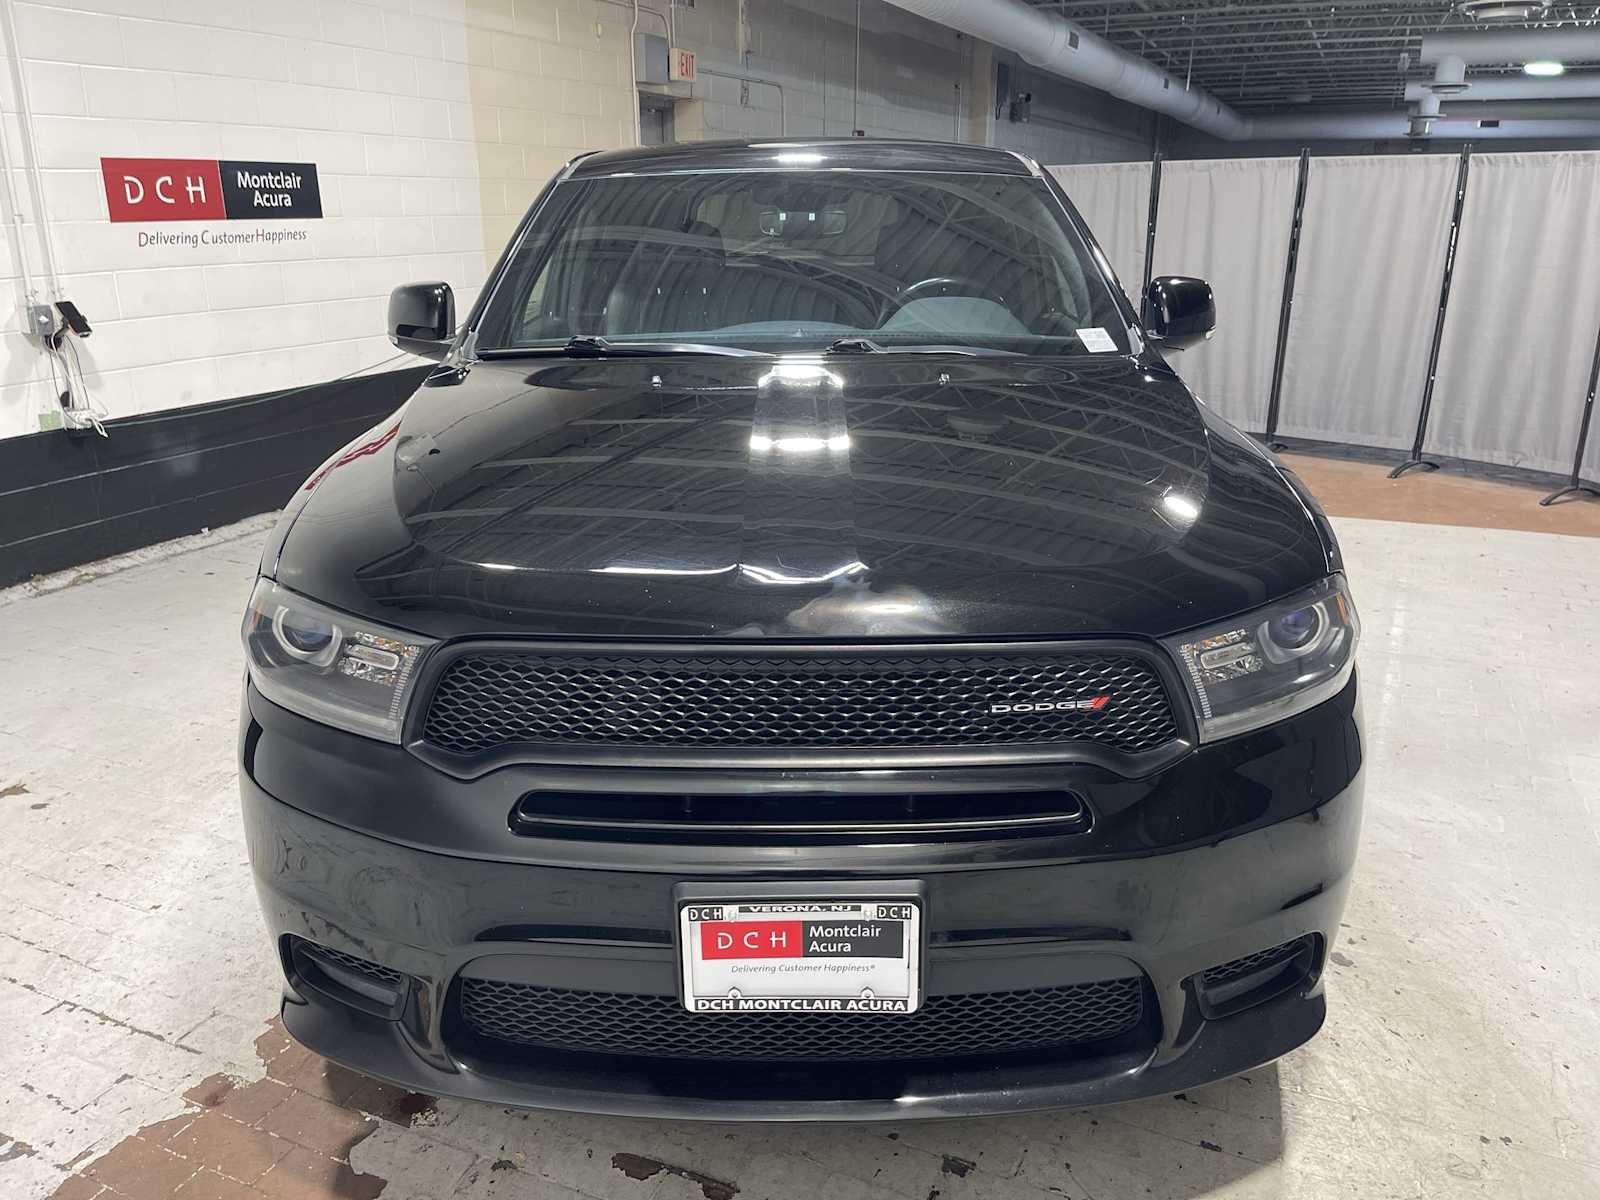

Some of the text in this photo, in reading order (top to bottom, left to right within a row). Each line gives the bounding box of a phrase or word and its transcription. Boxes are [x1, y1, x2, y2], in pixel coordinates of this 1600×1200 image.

[681, 53, 694, 80] EXIT
[237, 171, 302, 190] Montclair
[253, 190, 292, 208] Acura
[138, 231, 199, 248] Delivering
[991, 700, 1096, 713] DODGE
[749, 904, 852, 913] VERONA, NJ
[809, 925, 882, 938] Montclair
[809, 940, 851, 953] Acura
[731, 965, 776, 975] Delivering
[779, 964, 822, 973] Customer
[698, 1000, 907, 1011] DCH MONTCLAIR ACURA
